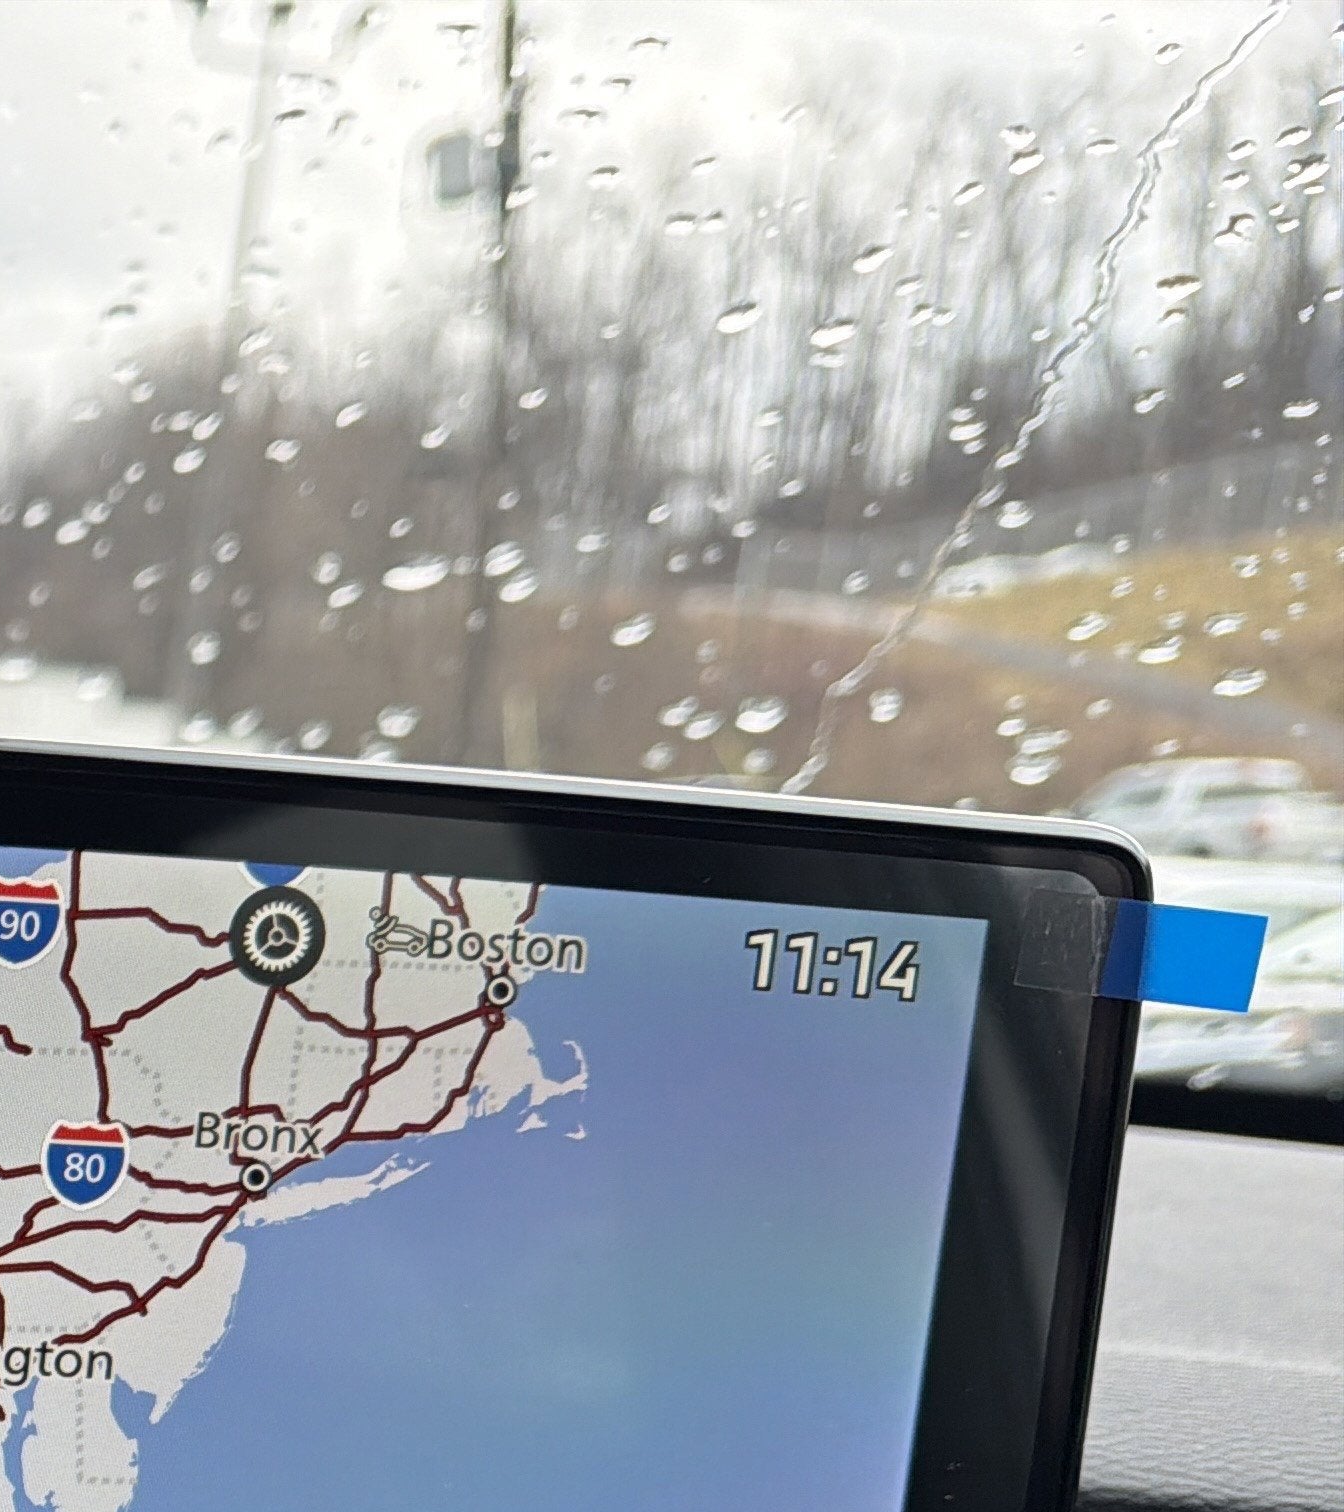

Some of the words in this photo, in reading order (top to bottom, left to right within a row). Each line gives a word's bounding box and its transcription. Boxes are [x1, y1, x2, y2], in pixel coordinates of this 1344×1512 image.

[0, 909, 41, 942] 90
[428, 918, 586, 972] Boston
[744, 928, 921, 1001] 11:14
[193, 1111, 324, 1156] Bronx
[64, 1152, 106, 1184] 80
